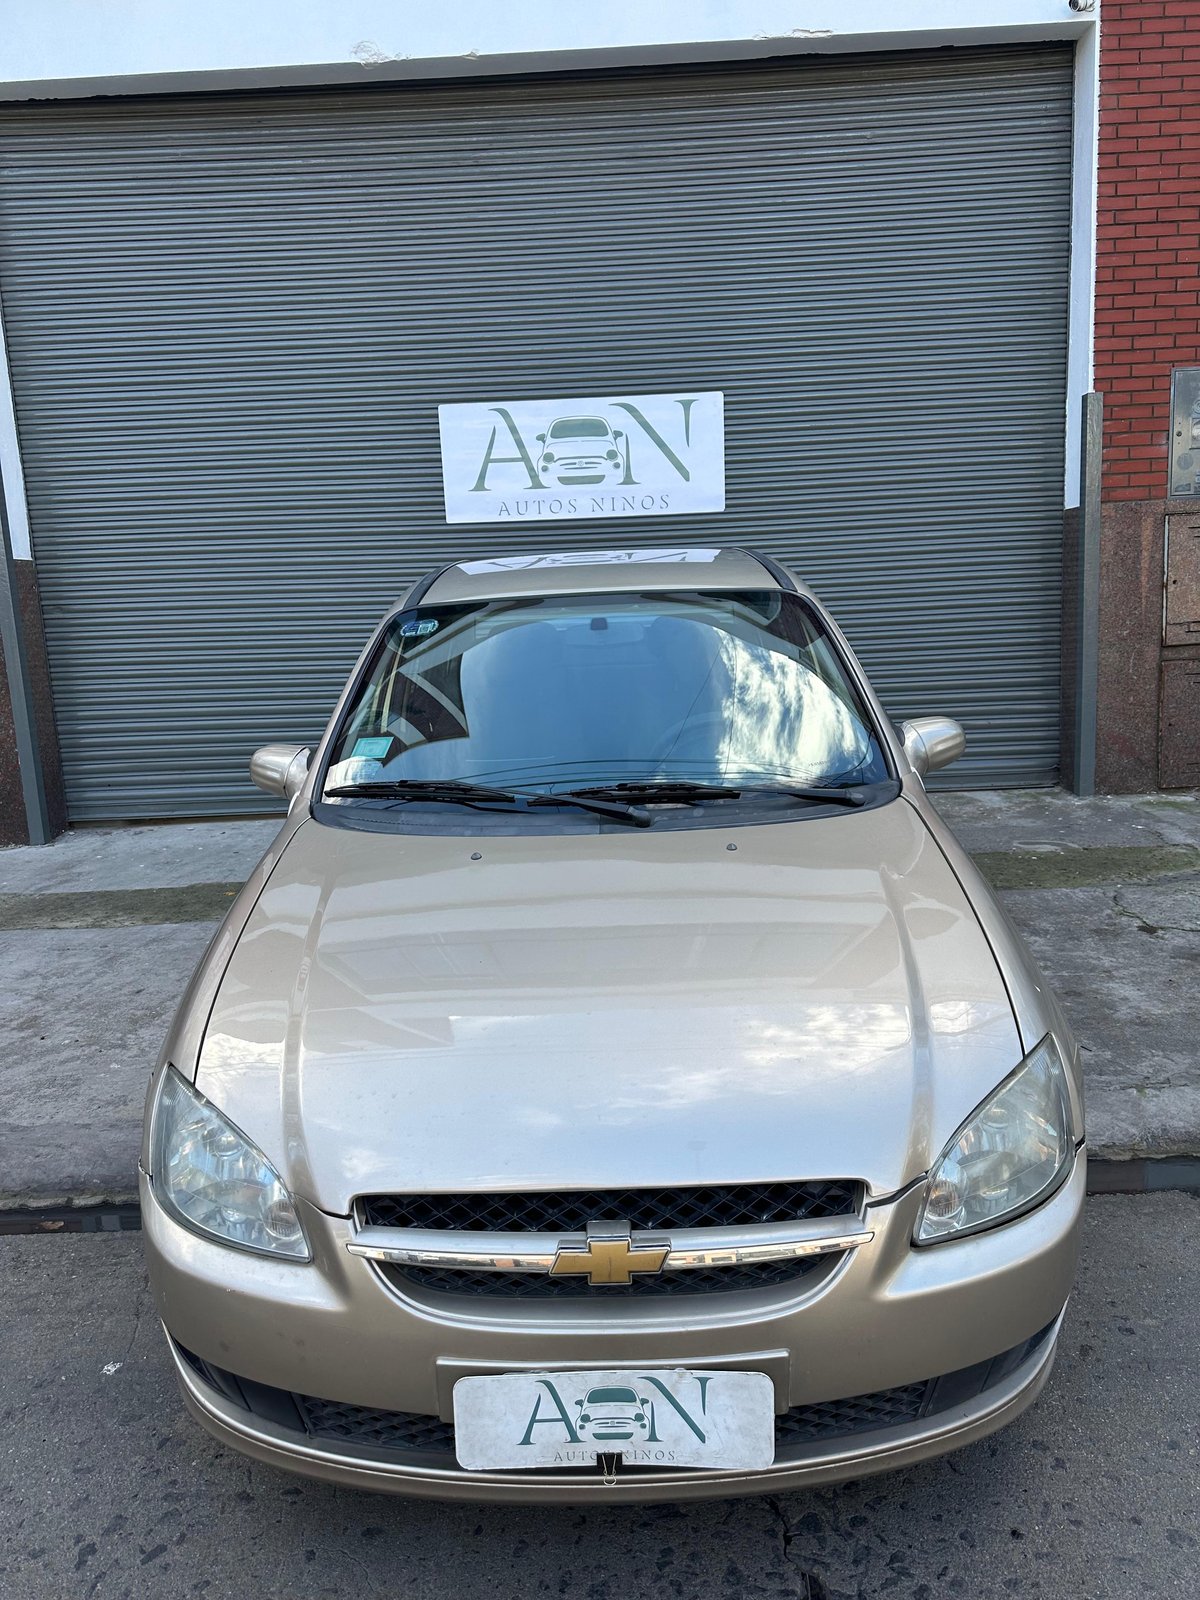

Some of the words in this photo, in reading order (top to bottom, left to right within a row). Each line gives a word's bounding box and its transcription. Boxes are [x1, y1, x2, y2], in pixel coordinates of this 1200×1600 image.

[498, 499, 577, 517] AUTOS
[590, 494, 670, 513] NINOS
[554, 1450, 609, 1462] AUTO
